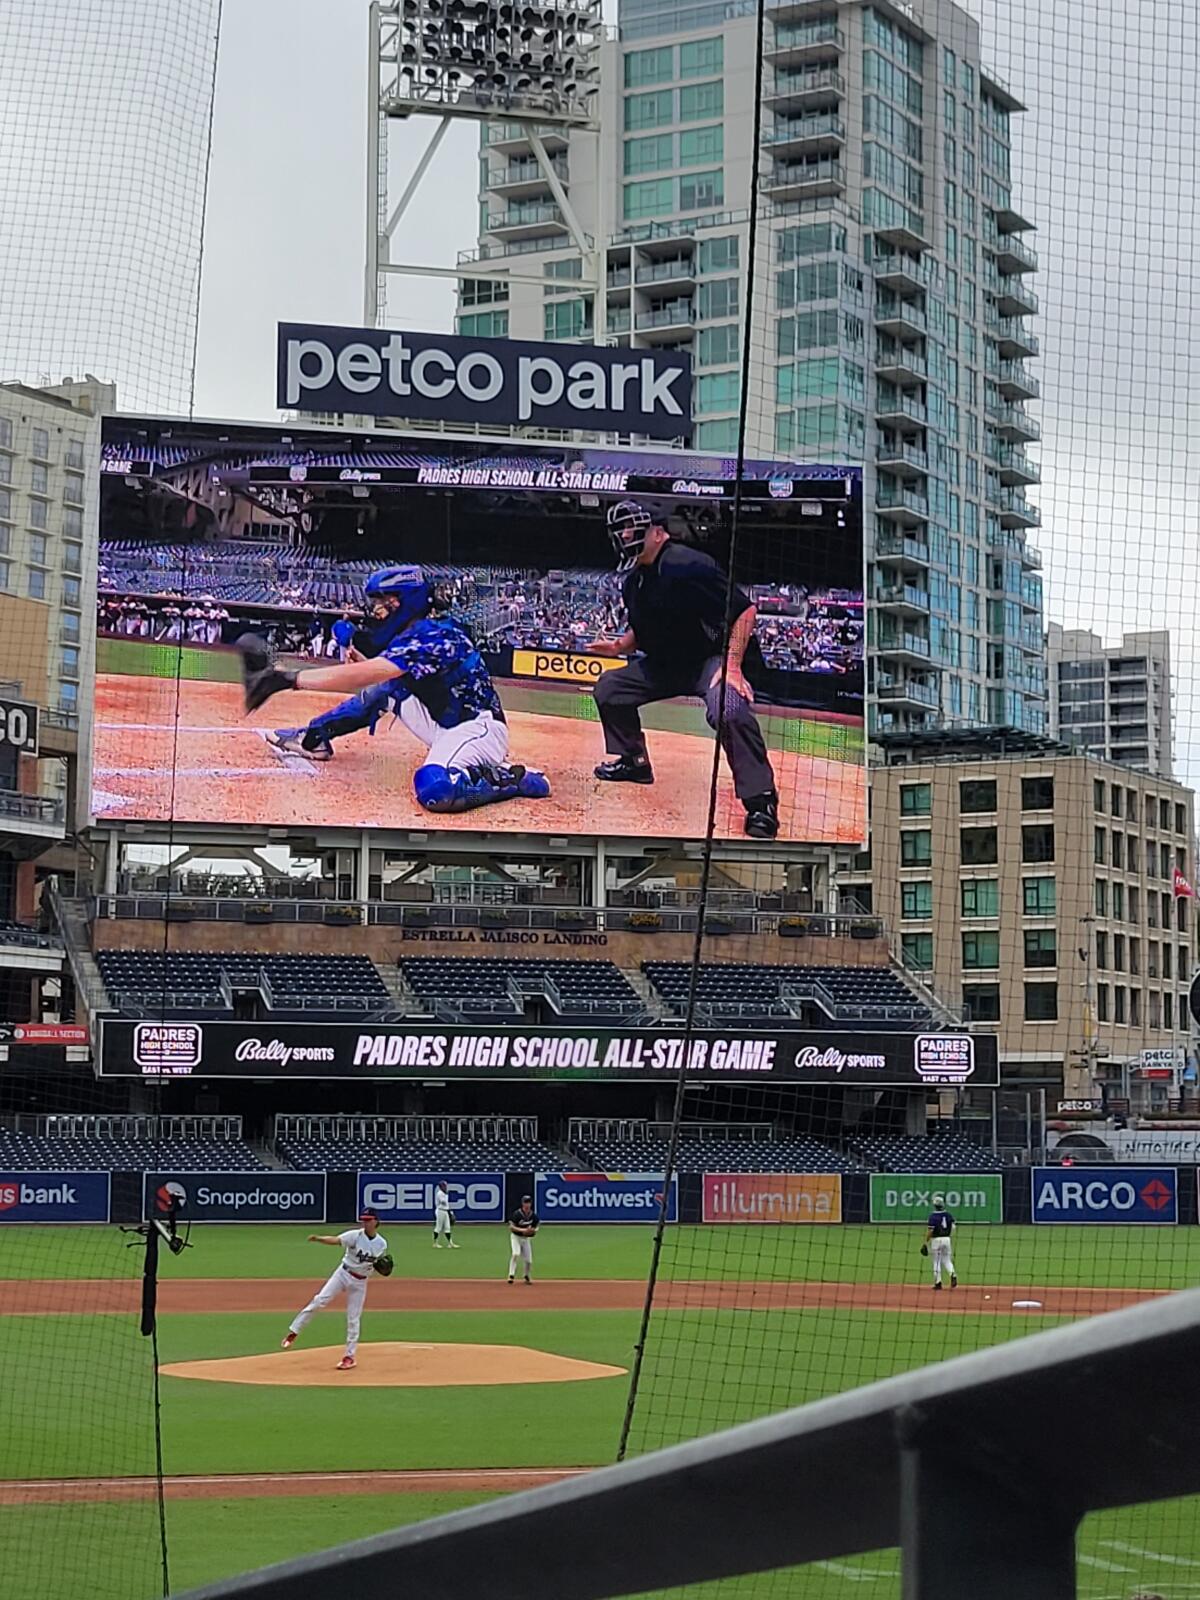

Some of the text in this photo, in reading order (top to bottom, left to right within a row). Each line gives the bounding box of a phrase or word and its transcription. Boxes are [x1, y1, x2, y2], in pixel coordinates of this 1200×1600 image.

[287, 334, 684, 420] petco park
[417, 467, 461, 484] PADRES
[461, 469, 490, 485] HIGH
[490, 469, 535, 487] SCHOOL
[592, 474, 629, 491] GAME
[536, 654, 602, 676] petco
[0, 706, 35, 748] O.
[401, 929, 608, 946] ESTRELLA JALISCO LANDING
[141, 1028, 196, 1041] PADRES
[920, 1039, 969, 1052] PADRES
[235, 1038, 335, 1066] Bally SPORTS
[352, 1035, 777, 1071] PADRES HIGH SCHOOL ALL-STAR GAME
[794, 1046, 886, 1073] Bally SPORTS
[1145, 1050, 1178, 1061] petc
[1057, 1100, 1092, 1113] petco
[0, 1183, 78, 1204] s bank
[196, 1187, 315, 1210] Snapdragon
[363, 1183, 500, 1210] GEICO
[545, 1187, 653, 1208] Southwest
[712, 1182, 830, 1214] illumina
[1036, 1181, 1136, 1210] ARCO
